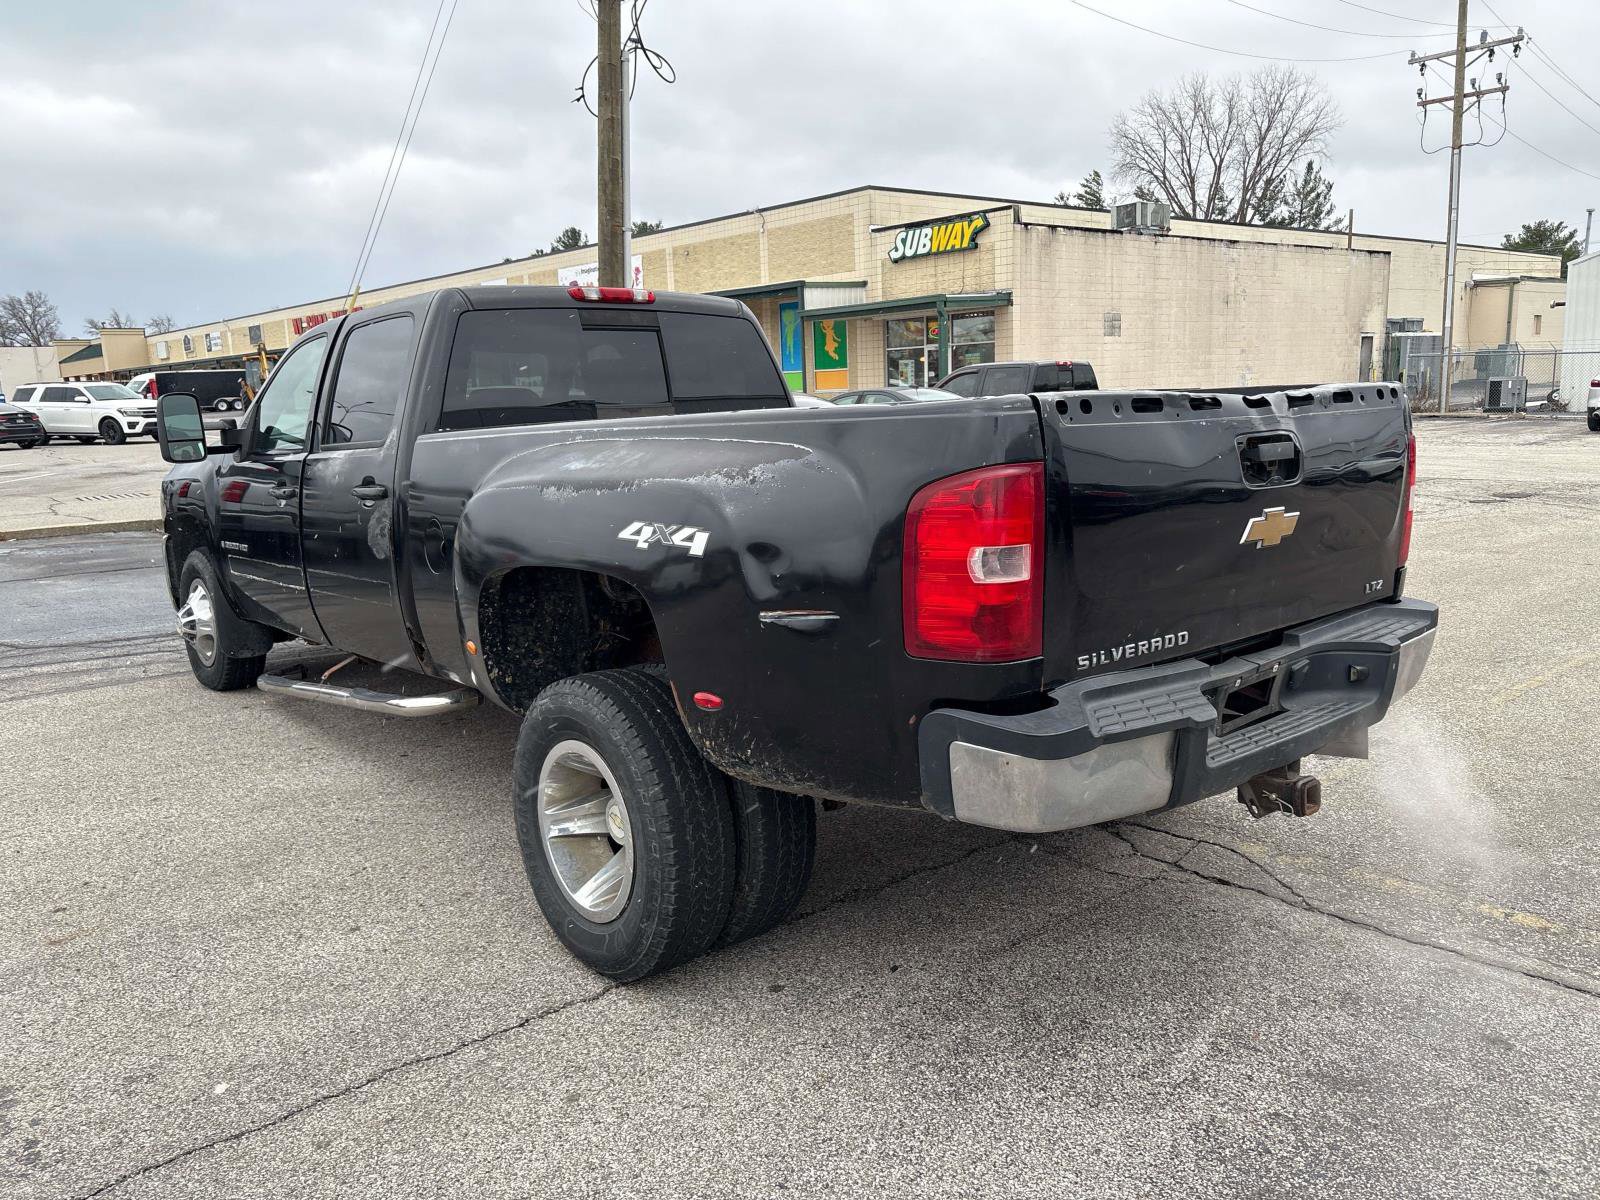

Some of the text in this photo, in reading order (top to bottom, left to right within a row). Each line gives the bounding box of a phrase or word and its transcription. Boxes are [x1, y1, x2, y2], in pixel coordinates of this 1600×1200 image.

[889, 215, 985, 260] SUBWAY
[1365, 579, 1384, 594] LTZ
[1077, 631, 1189, 671] SILVERADO
